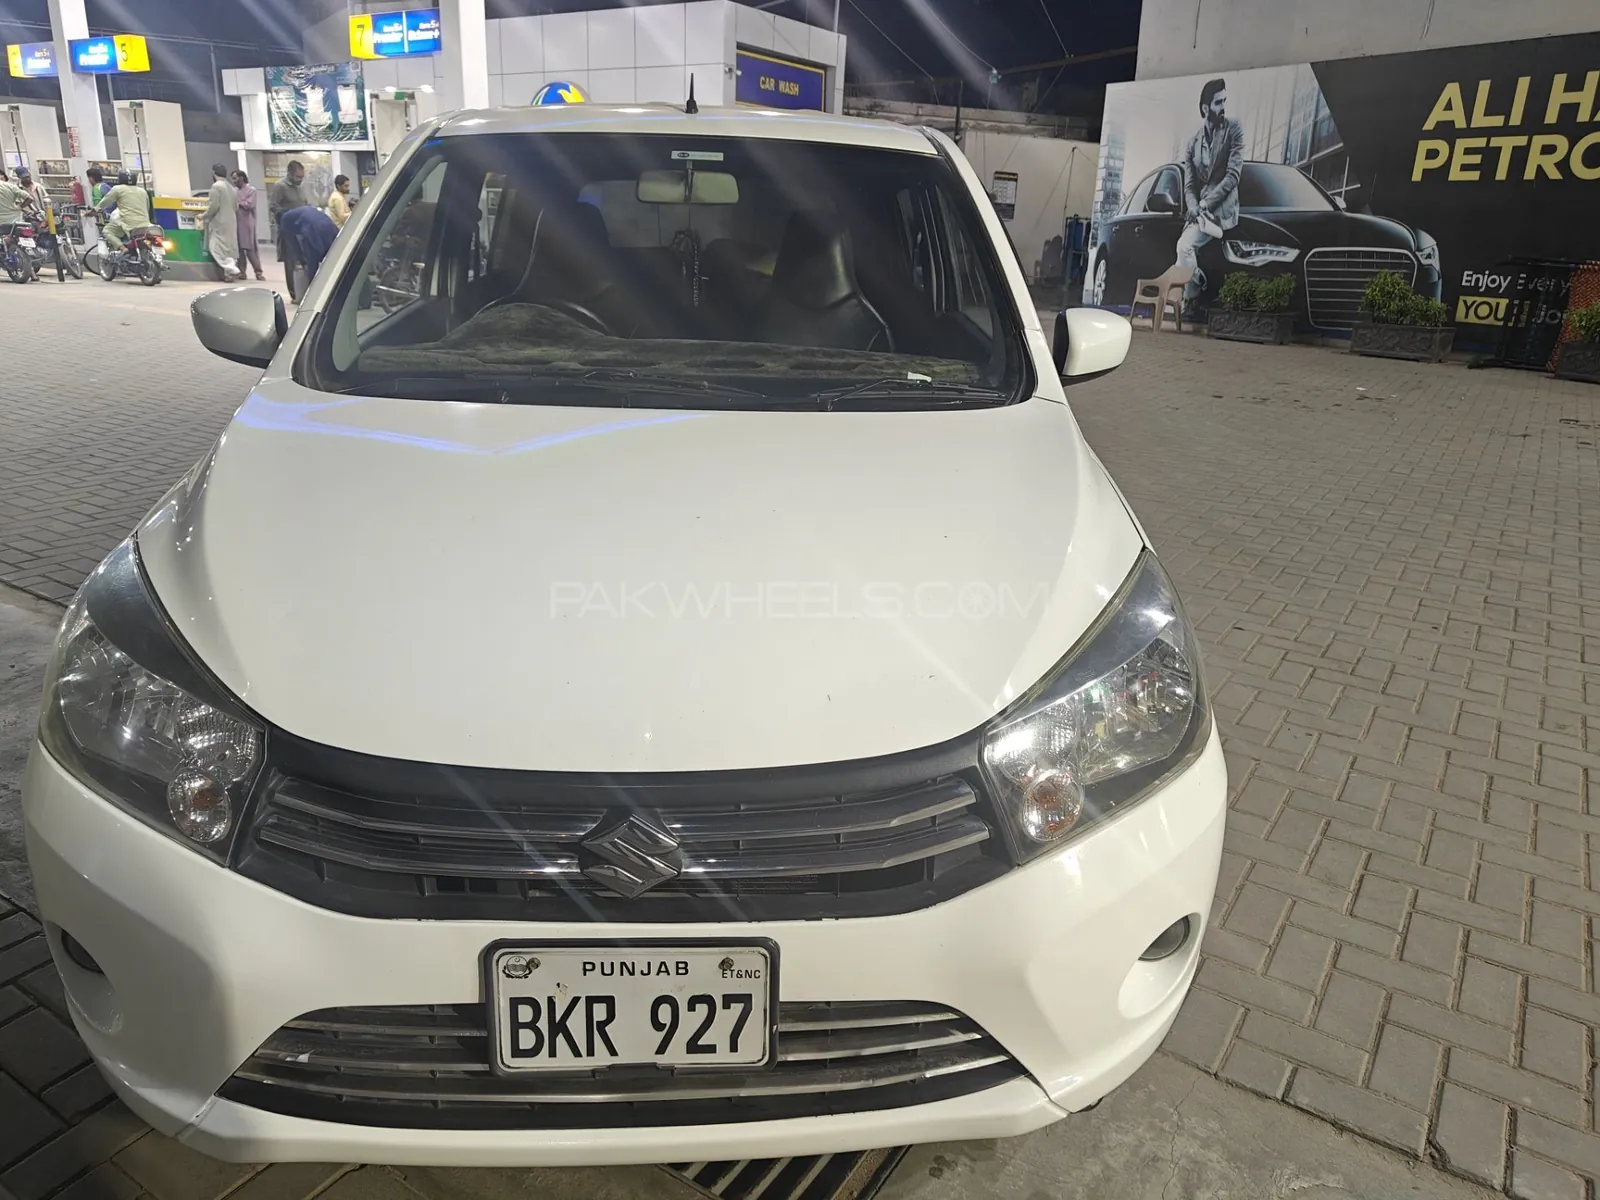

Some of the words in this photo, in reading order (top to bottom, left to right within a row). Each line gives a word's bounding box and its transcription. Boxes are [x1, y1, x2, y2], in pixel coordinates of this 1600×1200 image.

[356, 24, 365, 47] 7
[120, 43, 129, 63] 5
[760, 76, 775, 91] CAR
[779, 80, 799, 96] WASH
[1422, 75, 1532, 131] ALI
[1543, 70, 1600, 125] H
[1461, 270, 1512, 294] Enjoy
[582, 961, 690, 977] PUNJAB
[721, 968, 761, 980] ET&NC
[509, 994, 619, 1059] BKR
[650, 993, 753, 1055] 927
